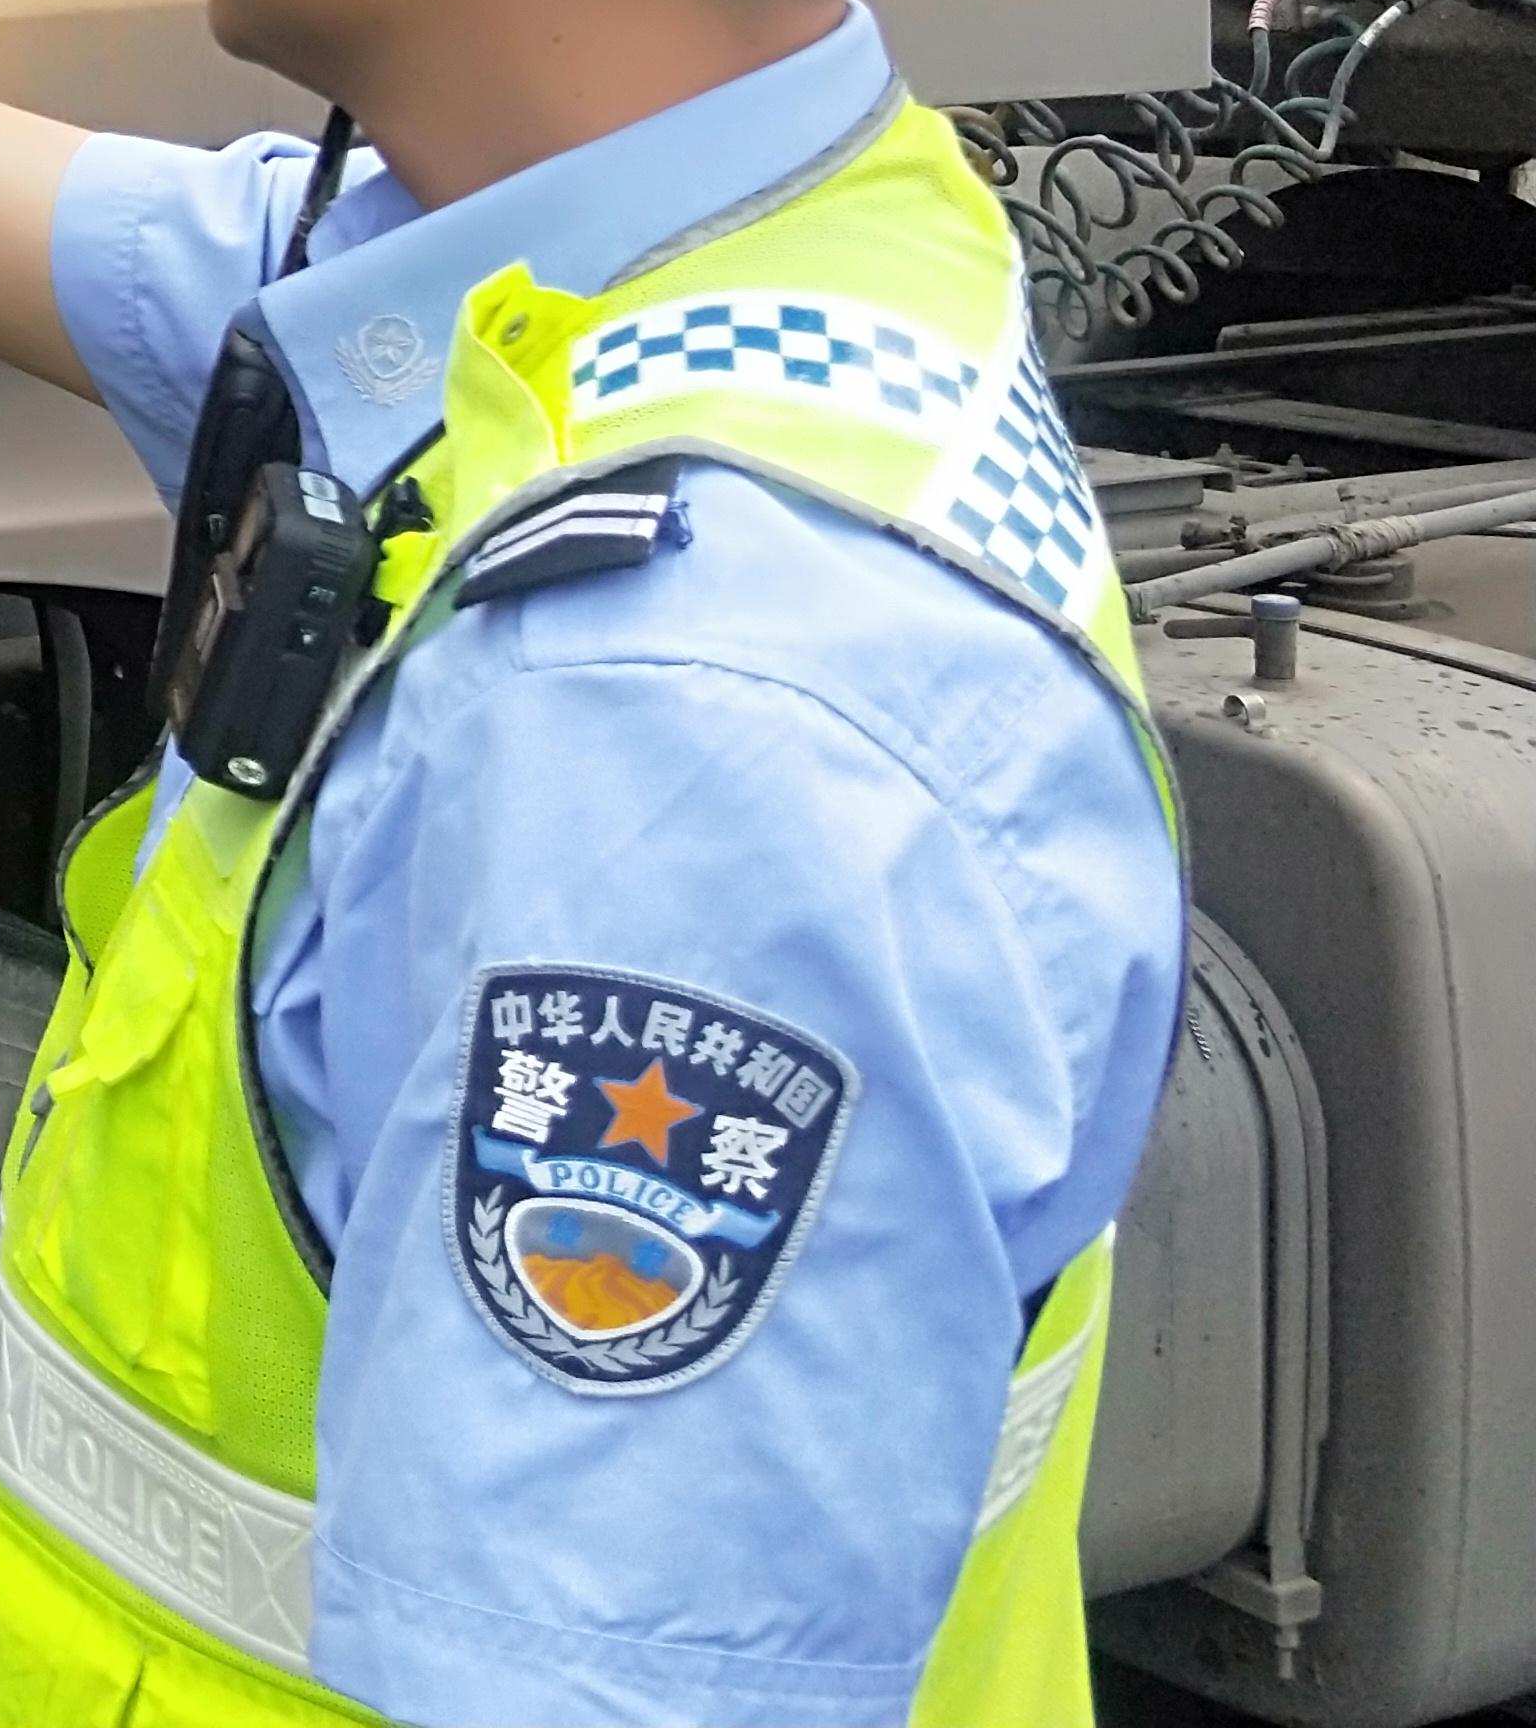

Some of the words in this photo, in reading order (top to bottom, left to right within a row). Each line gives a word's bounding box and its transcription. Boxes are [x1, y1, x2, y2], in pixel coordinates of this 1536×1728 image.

[491, 990, 834, 1129] 中华人民共和国
[548, 1161, 696, 1224] POLICE
[34, 1402, 226, 1596] POLICE
